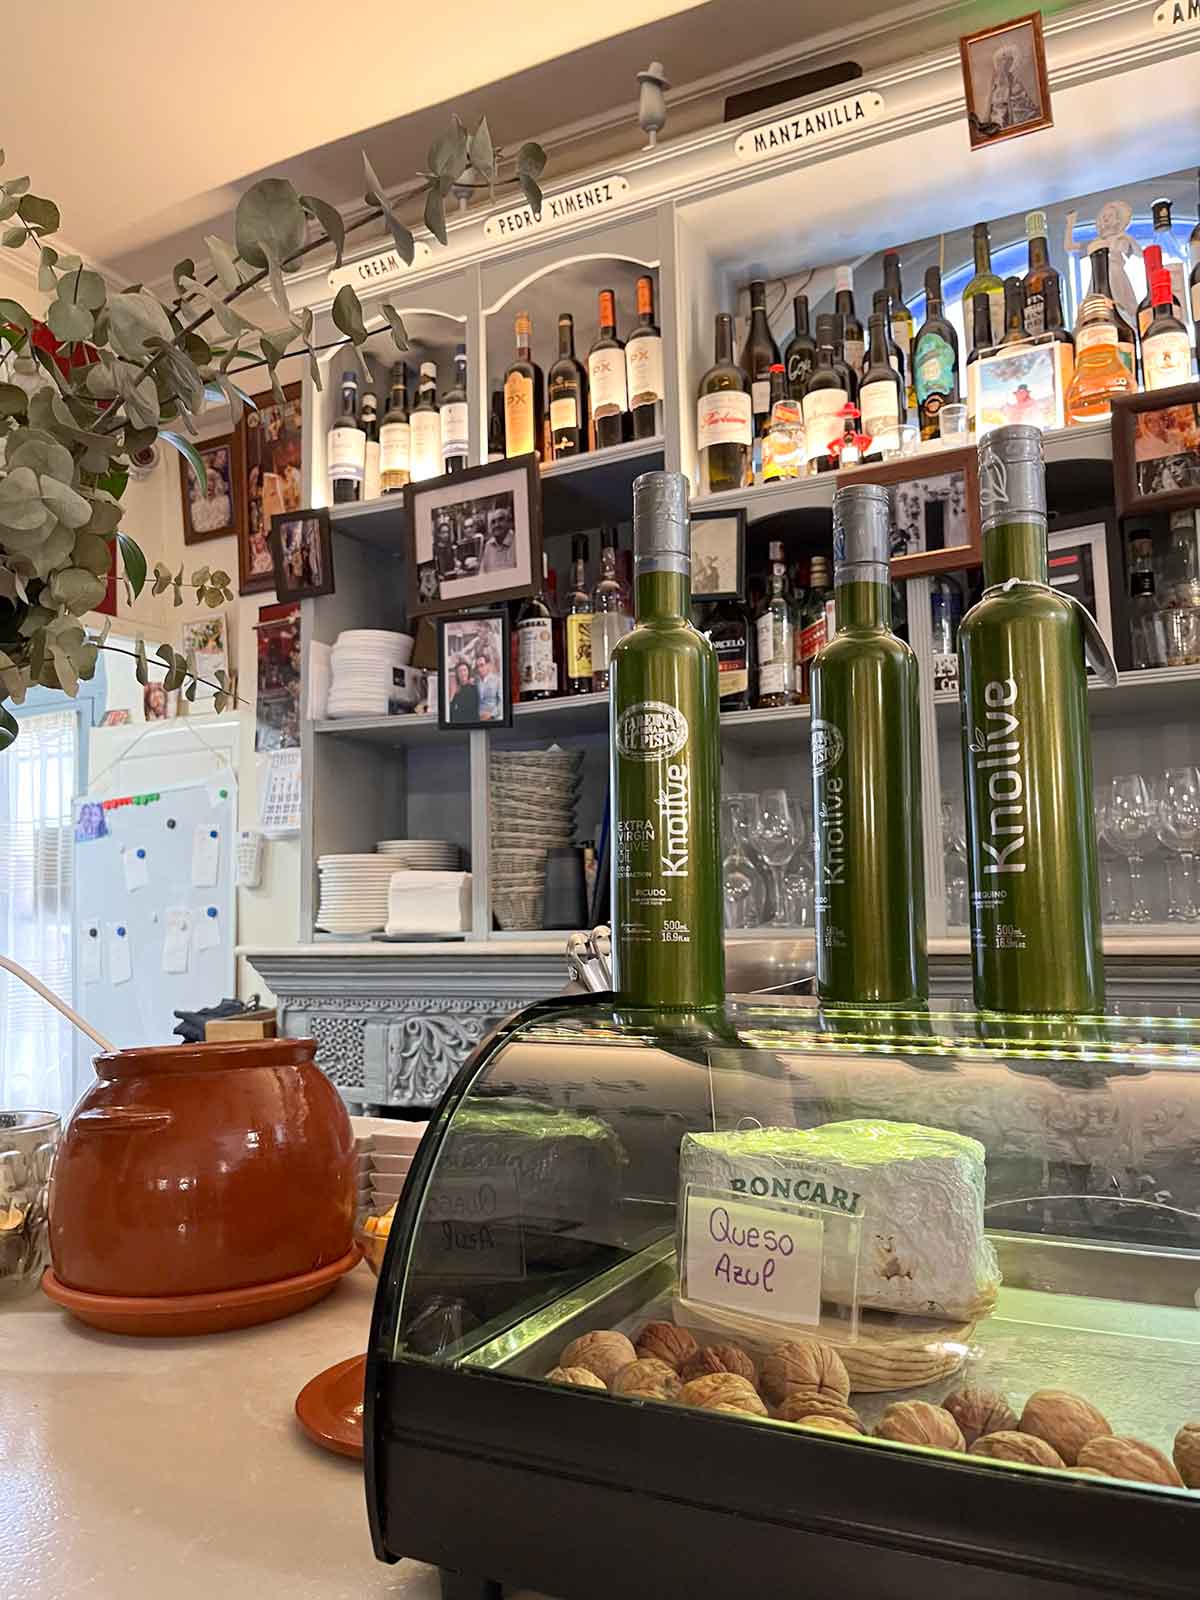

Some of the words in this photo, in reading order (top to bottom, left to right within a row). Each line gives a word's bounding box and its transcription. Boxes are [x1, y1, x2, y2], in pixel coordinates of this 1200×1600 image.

[753, 101, 865, 153] MANZANILLA
[497, 210, 542, 234] PEDRO
[549, 184, 613, 219] XIMENEZ
[358, 255, 400, 280] CREAM
[976, 680, 1027, 874] Knolive
[617, 820, 654, 832] EXTRA
[617, 831, 655, 842] VIRGIN
[660, 764, 689, 878] Knolive
[823, 776, 846, 886] Knolive
[709, 1207, 795, 1257] Queso
[714, 1253, 776, 1293] Azul
